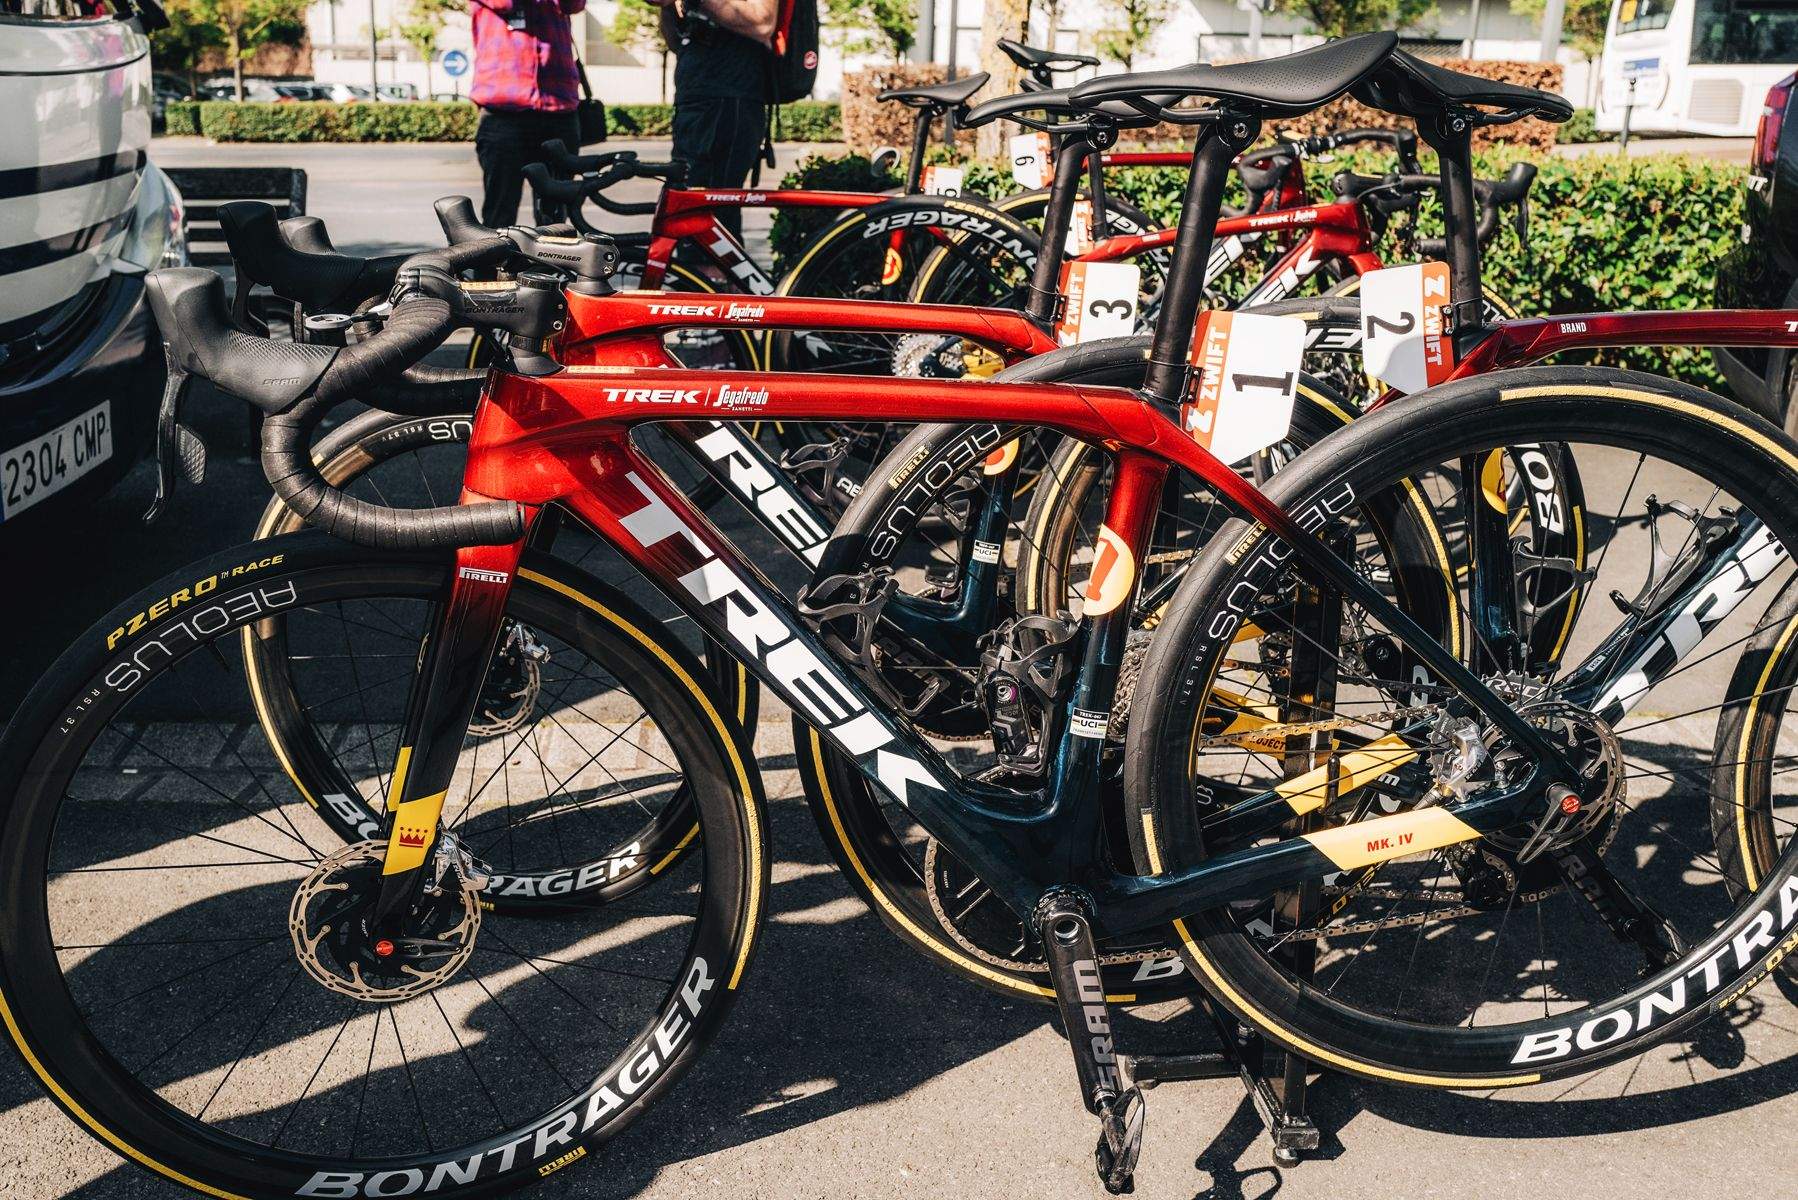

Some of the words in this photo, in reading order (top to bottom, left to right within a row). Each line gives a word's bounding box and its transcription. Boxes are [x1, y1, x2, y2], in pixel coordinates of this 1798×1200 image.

[1015, 154, 1035, 166] 6
[537, 251, 582, 262] BONTRAGER
[647, 304, 718, 317] TREK
[1065, 273, 1085, 326] ZWIFT
[1089, 299, 1133, 321] 3
[1367, 312, 1415, 340] 2
[1425, 304, 1442, 366] ZWIFT
[1560, 322, 1587, 333] BRAND
[1200, 326, 1228, 401] ZWIFT
[262, 377, 301, 386] SRAM
[1232, 371, 1294, 397] 1
[602, 388, 702, 404] TREK
[713, 384, 769, 407] Segafredo
[6, 434, 67, 507] 2304
[73, 411, 106, 467] CMP
[888, 444, 930, 491] PIRELLI
[870, 424, 1001, 560] AEOLUS
[459, 566, 509, 584] PIRELLI
[106, 575, 218, 651] PZERO
[232, 554, 285, 577] RACE
[105, 580, 298, 692] AEOLUS
[618, 471, 949, 808] TREK
[1191, 645, 1208, 671] RSL
[77, 688, 101, 712] RSL
[60, 717, 75, 734] 37
[1080, 720, 1098, 728] UCI
[1367, 838, 1395, 853] MK.
[1398, 832, 1414, 846] IV
[1072, 959, 1124, 1093] SRAM
[295, 955, 716, 1199] BONTRAGER
[538, 1145, 587, 1177] PIRELLI
